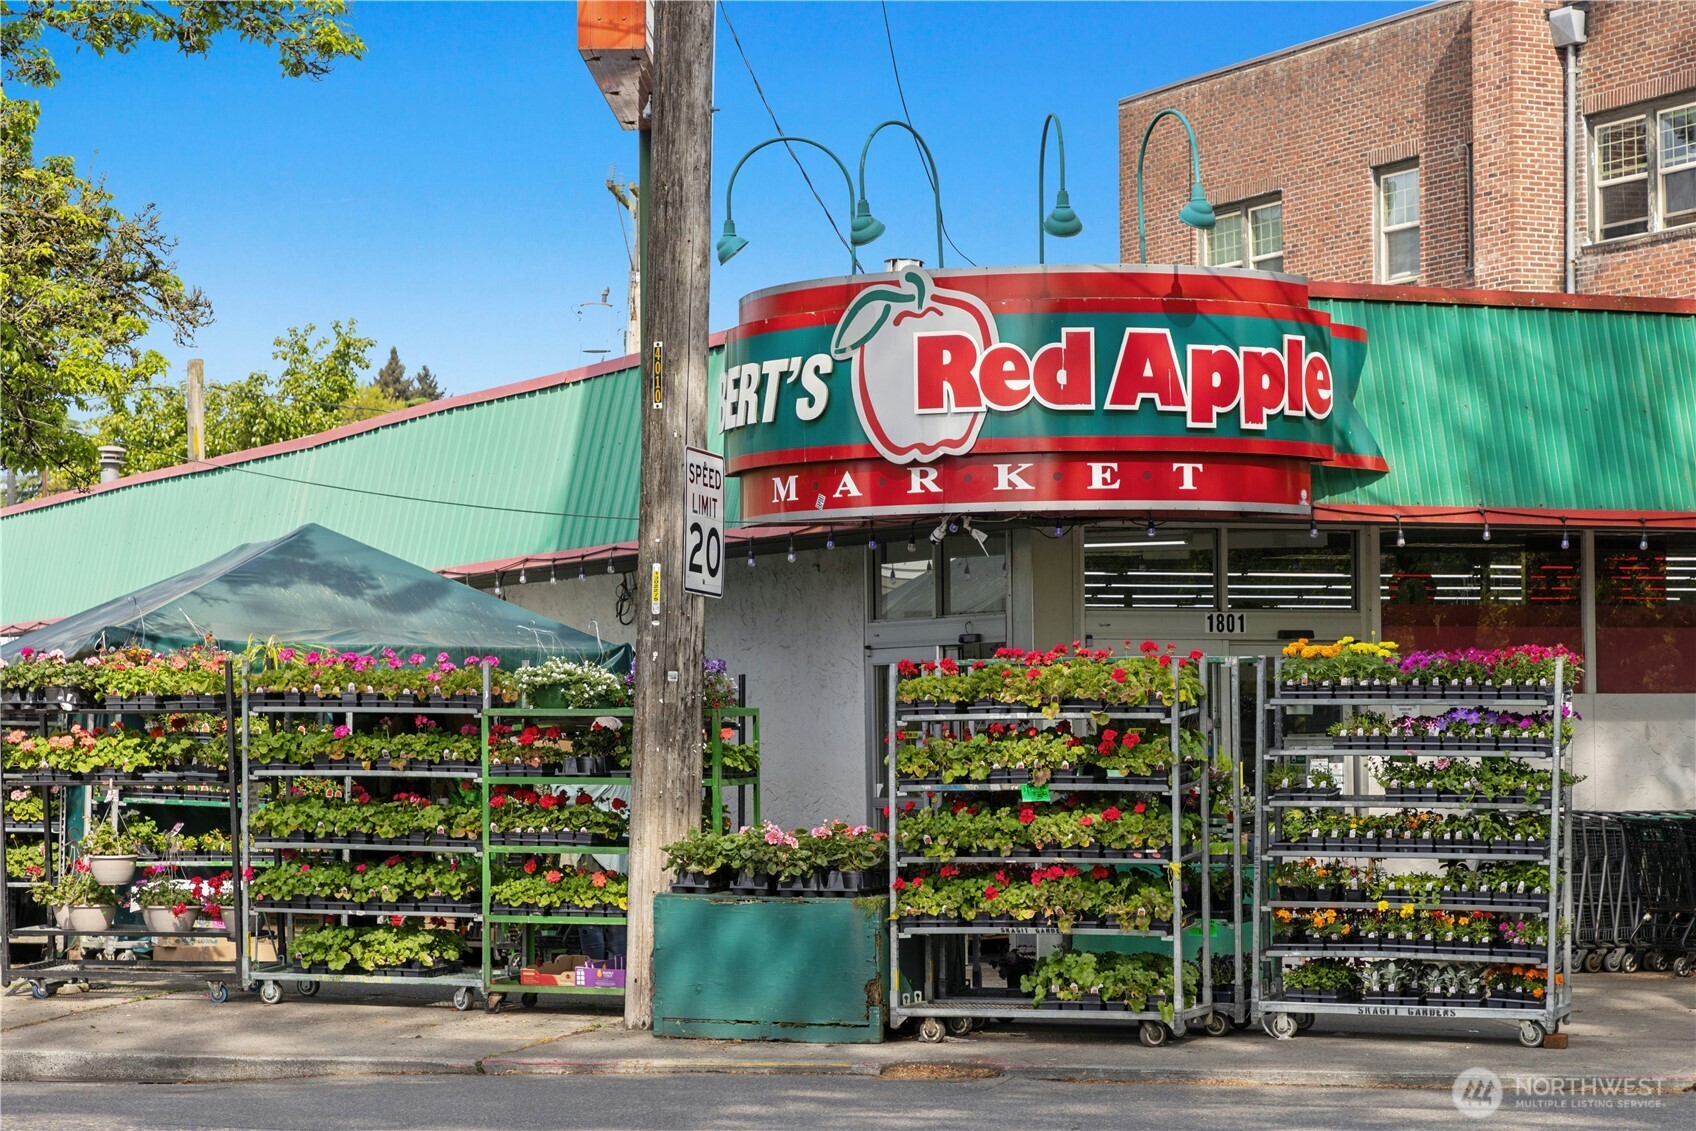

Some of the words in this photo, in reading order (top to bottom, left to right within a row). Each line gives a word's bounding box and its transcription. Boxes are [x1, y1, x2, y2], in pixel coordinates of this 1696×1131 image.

[654, 347, 662, 403] 4010
[718, 354, 834, 434] BERT'S
[914, 327, 1096, 415] Red
[1103, 327, 1334, 430] Apple
[688, 463, 722, 490] SPEED
[772, 462, 1204, 503] MARKET
[692, 493, 718, 518] LIMIT
[688, 522, 721, 578] 20
[1207, 613, 1245, 633] 1801
[1357, 1006, 1399, 1015] SKAGIT
[1407, 1008, 1457, 1017] GARDENS
